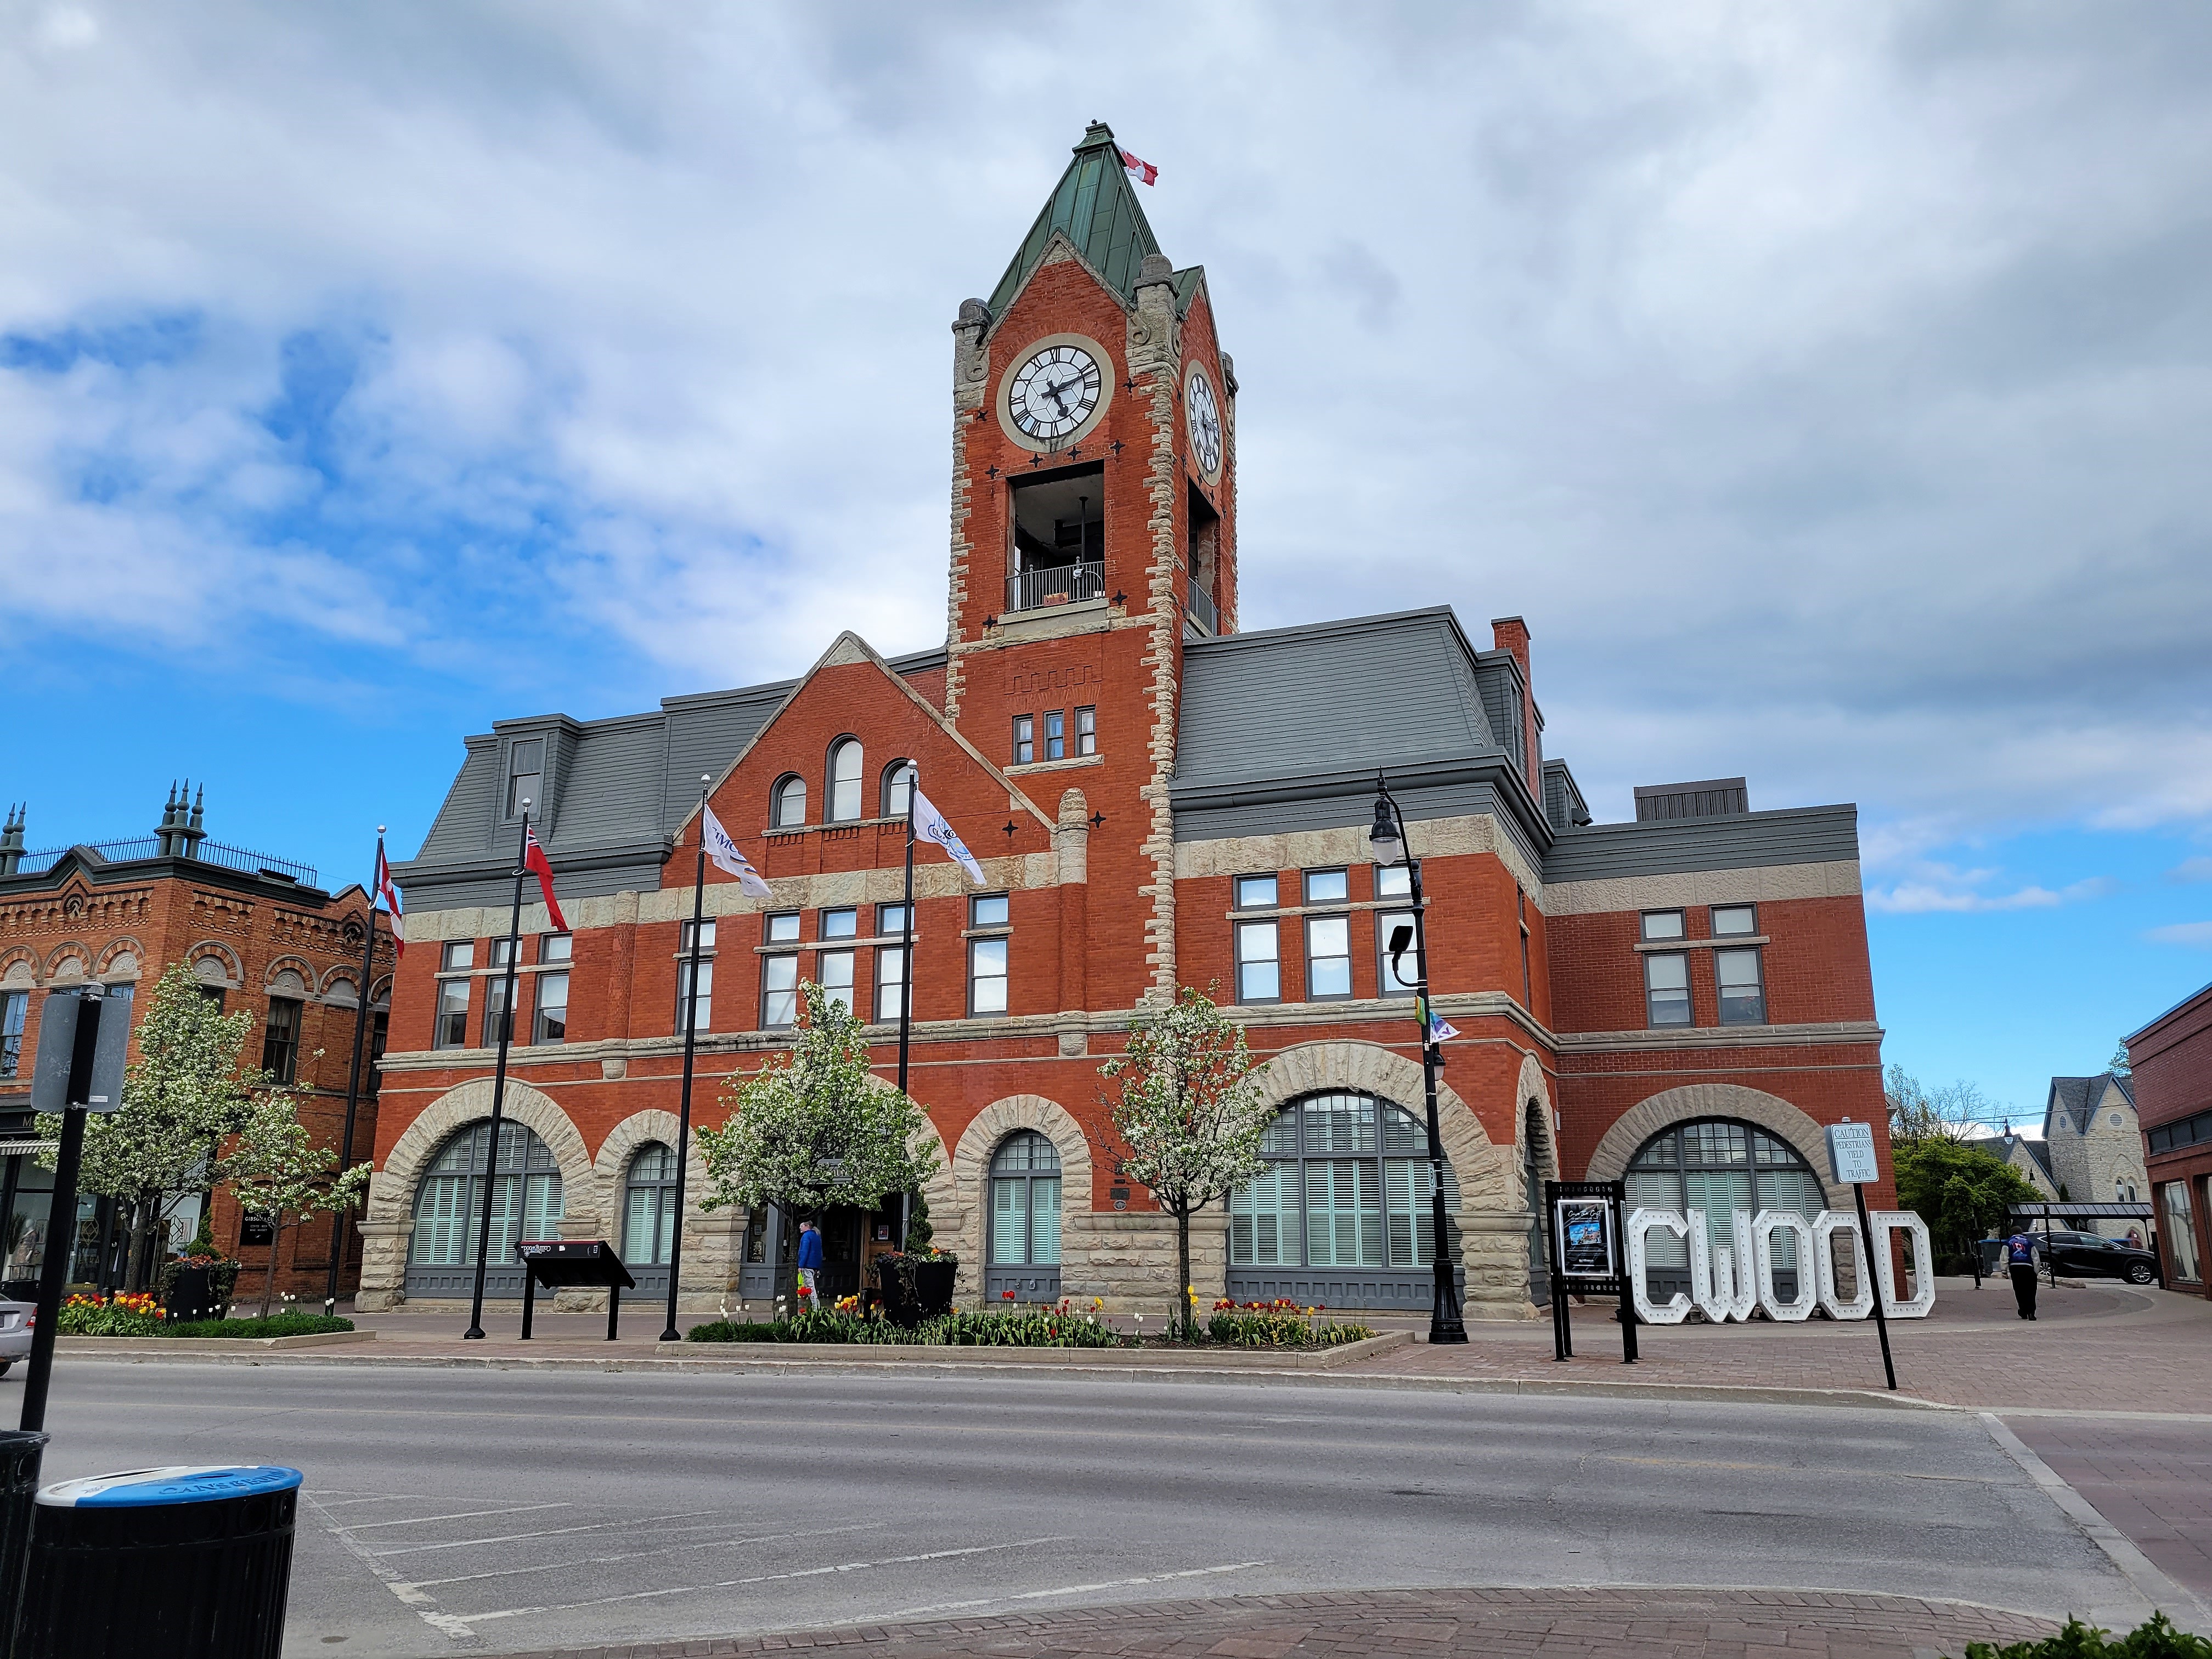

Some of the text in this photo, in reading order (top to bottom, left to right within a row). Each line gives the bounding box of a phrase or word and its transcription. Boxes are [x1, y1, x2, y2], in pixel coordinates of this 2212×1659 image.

[1835, 1128, 1869, 1138] CAUTION
[1836, 1140, 1872, 1149] PEDESTRIANS
[1847, 1150, 1864, 1159] YIELD
[1853, 1160, 1861, 1168] TO
[1847, 1169, 1871, 1178] TRAFFIC
[1628, 1207, 1936, 1324] CWOOD
